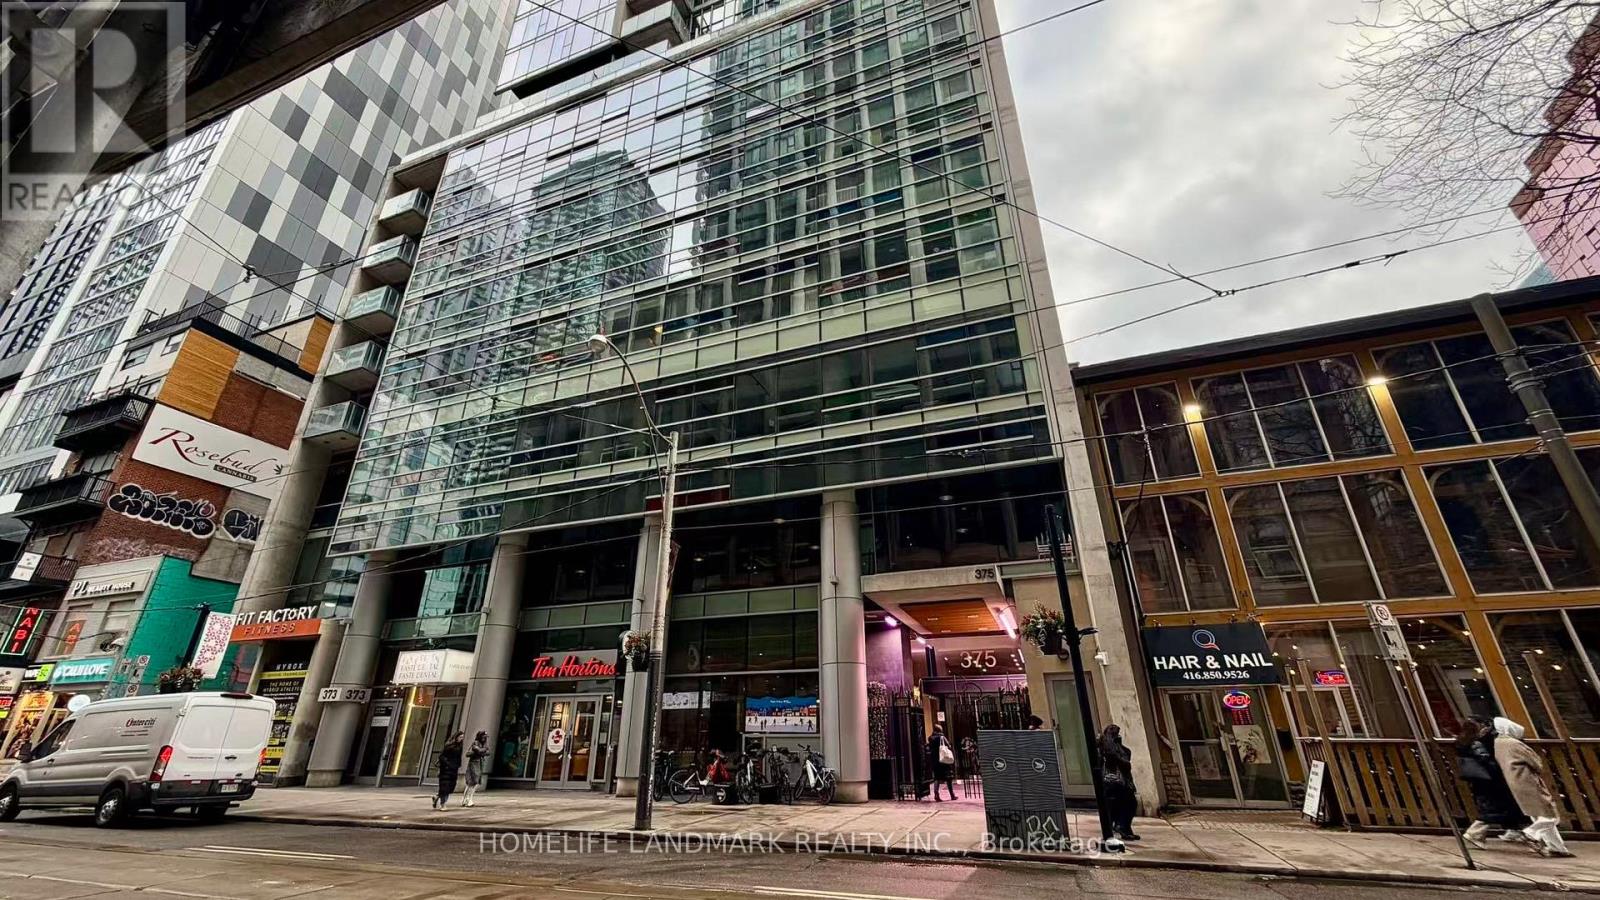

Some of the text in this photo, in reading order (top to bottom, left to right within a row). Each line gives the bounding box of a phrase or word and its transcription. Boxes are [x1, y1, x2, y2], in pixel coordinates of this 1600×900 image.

[149, 427, 277, 474] Rosebud
[215, 465, 256, 481] CANNABIS
[974, 568, 995, 580] 375
[236, 605, 318, 626] FIT FACTORY
[244, 623, 296, 637] FITNESS
[531, 655, 616, 678] Tim Hortons
[960, 650, 997, 668] 375
[1153, 653, 1274, 670] HAIR & NAIL
[1183, 670, 1250, 680] 416.850.9526
[322, 689, 366, 700] 373 373
[1226, 695, 1251, 705] OPEN
